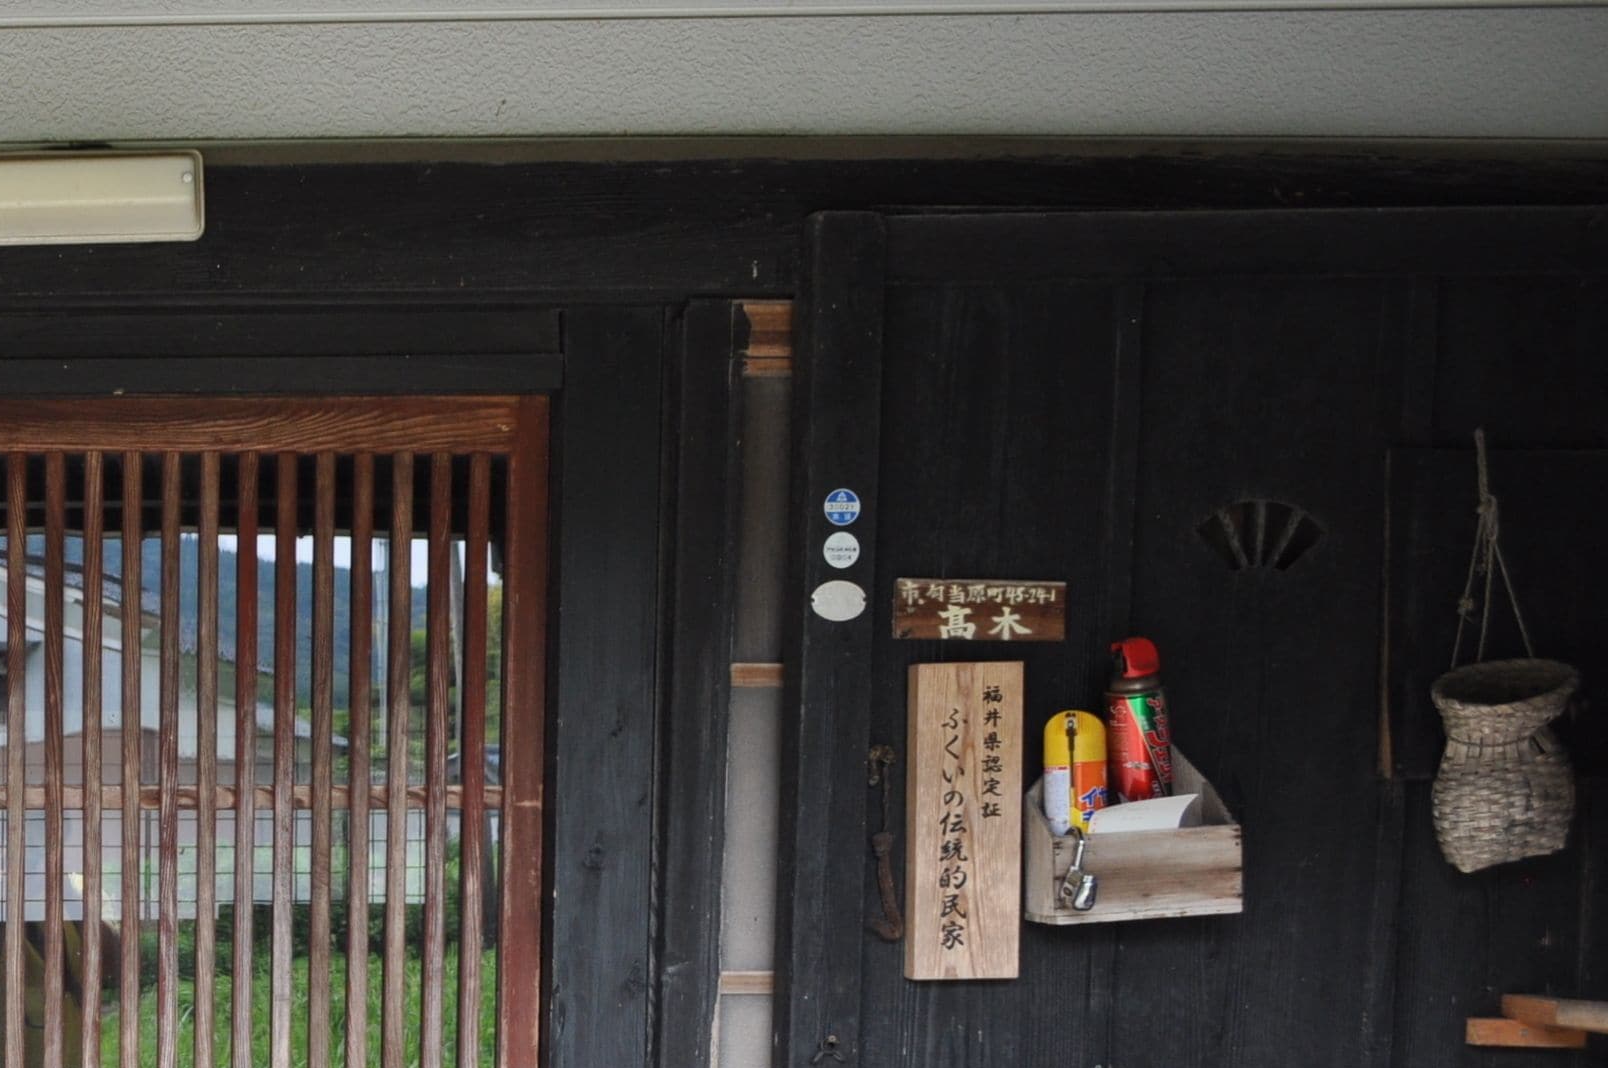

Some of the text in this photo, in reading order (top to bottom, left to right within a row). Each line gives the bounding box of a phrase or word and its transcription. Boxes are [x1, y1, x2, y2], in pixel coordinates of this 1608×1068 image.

[939, 708, 969, 951] ふくいの伝統的民家
[980, 685, 1004, 819] 福井県認定証
